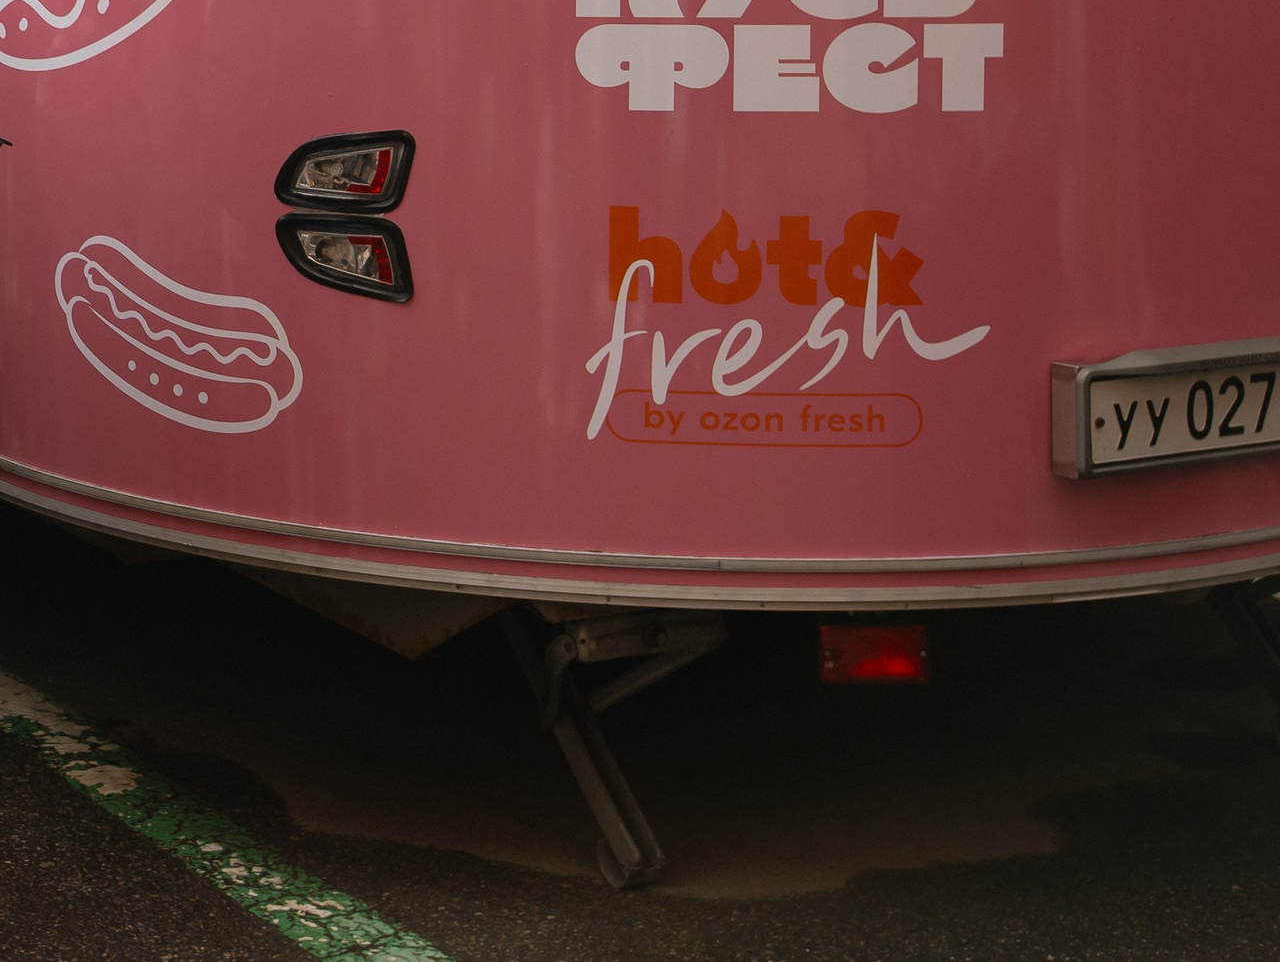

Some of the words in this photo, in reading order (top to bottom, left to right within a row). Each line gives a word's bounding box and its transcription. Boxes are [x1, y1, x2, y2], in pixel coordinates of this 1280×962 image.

[574, 22, 1004, 114] ФЕСТ
[585, 232, 991, 441] fresh
[644, 401, 685, 437] by
[699, 410, 784, 433] ozon
[799, 404, 885, 433] fresh
[1186, 371, 1277, 441] 027
